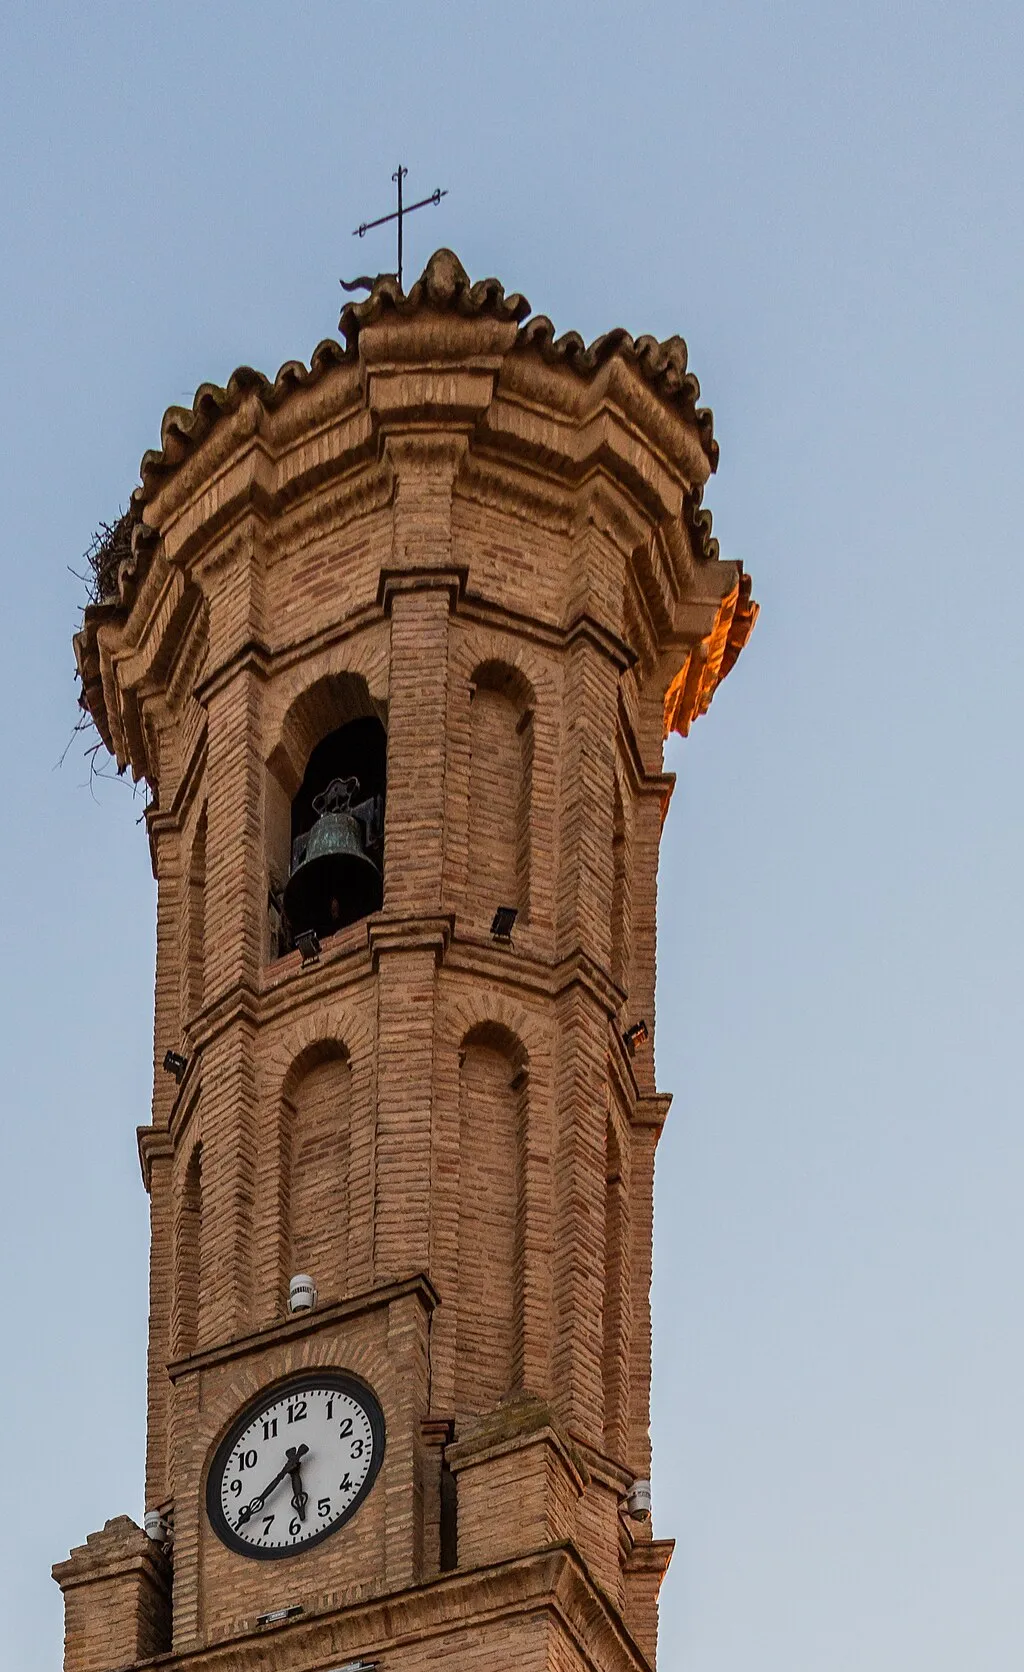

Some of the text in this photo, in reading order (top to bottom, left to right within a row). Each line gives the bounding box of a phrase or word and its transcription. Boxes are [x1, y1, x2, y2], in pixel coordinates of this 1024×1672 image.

[287, 1401, 307, 1424] 12
[326, 1400, 333, 1420] 1
[262, 1418, 278, 1441] 11
[339, 1418, 353, 1439] 2
[350, 1439, 364, 1459] 3
[238, 1450, 258, 1472] 10
[230, 1480, 242, 1497] 9
[339, 1472, 353, 1493] 4
[317, 1497, 331, 1517] 5
[262, 1515, 275, 1536] 7
[289, 1517, 301, 1536] 6
